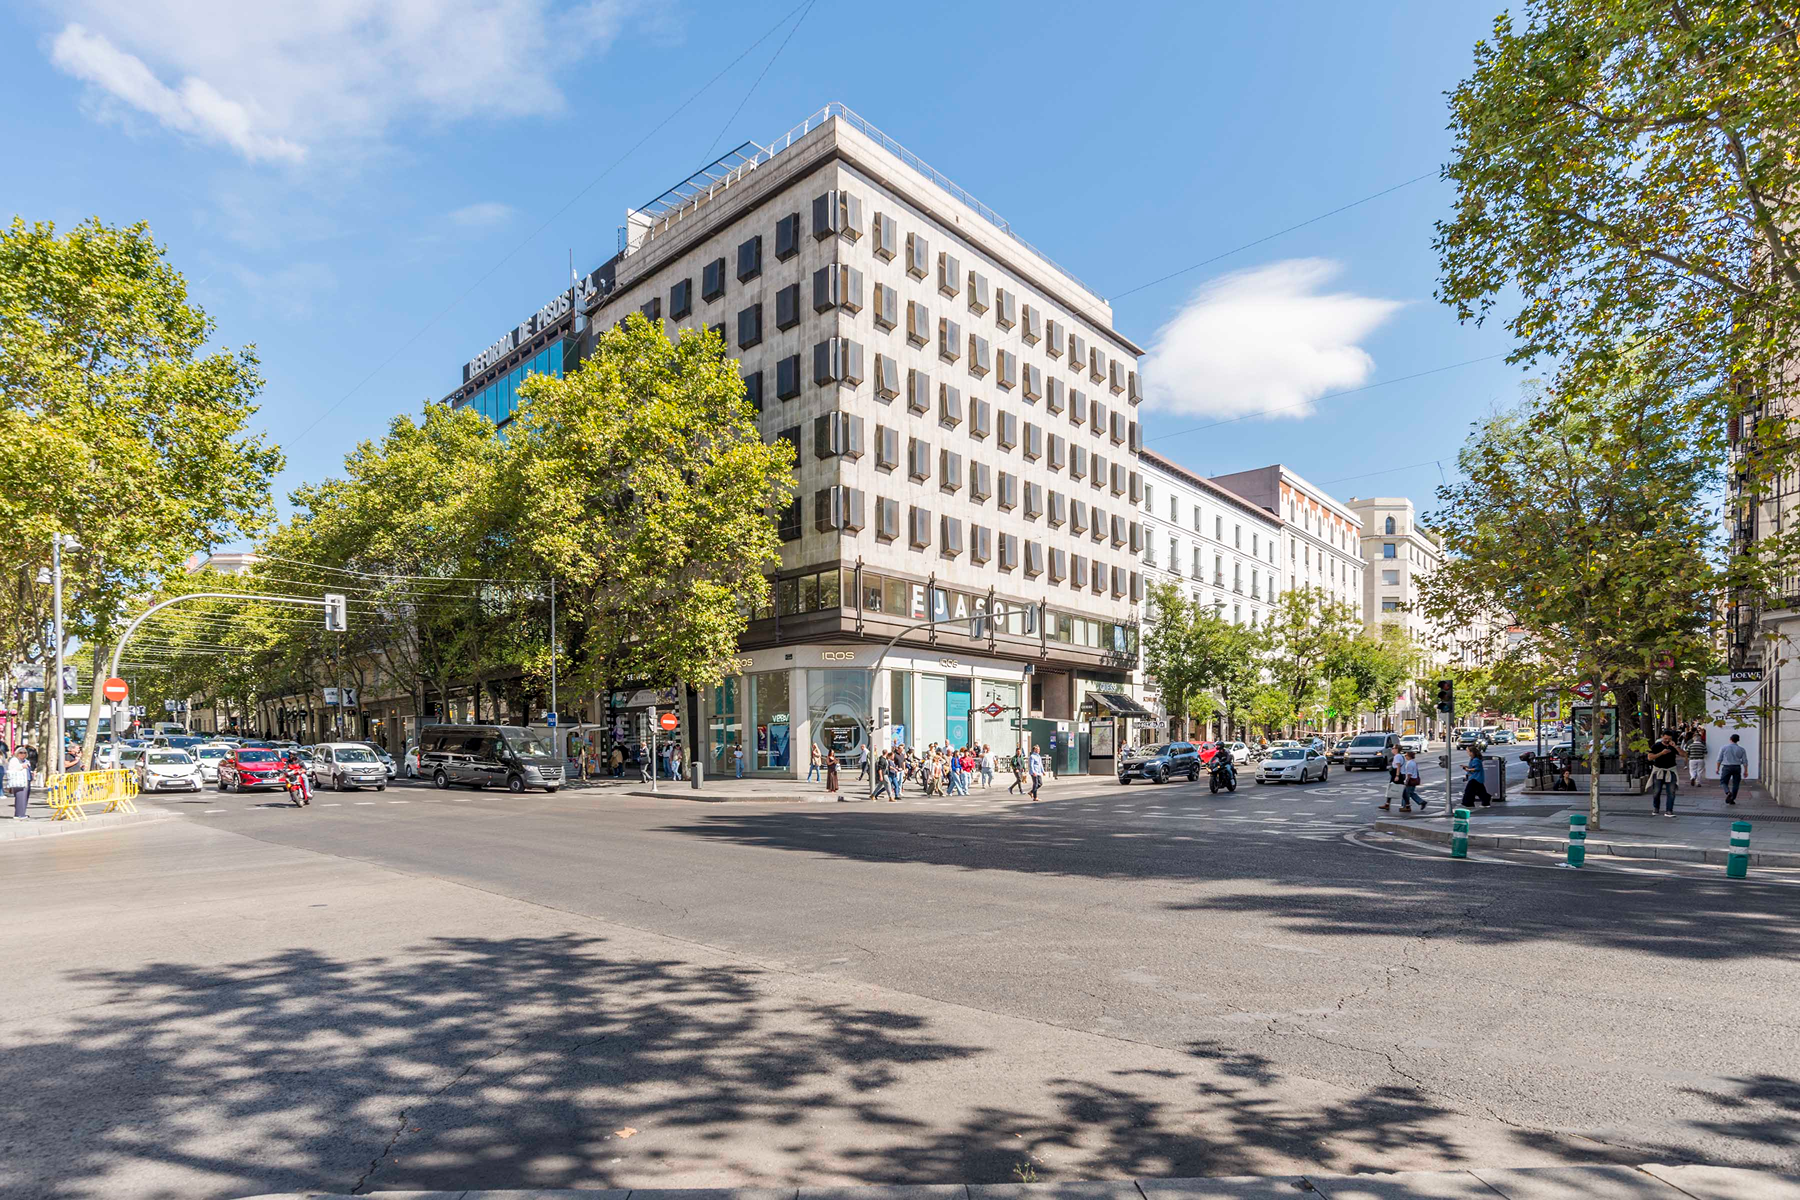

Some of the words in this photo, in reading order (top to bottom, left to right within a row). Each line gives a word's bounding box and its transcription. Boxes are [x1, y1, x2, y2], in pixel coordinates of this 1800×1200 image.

[469, 332, 514, 379] REFORMA
[518, 317, 533, 345] DE
[536, 290, 571, 331] PISOS
[822, 652, 855, 661] IQOS
[1731, 671, 1762, 680] LOEWE
